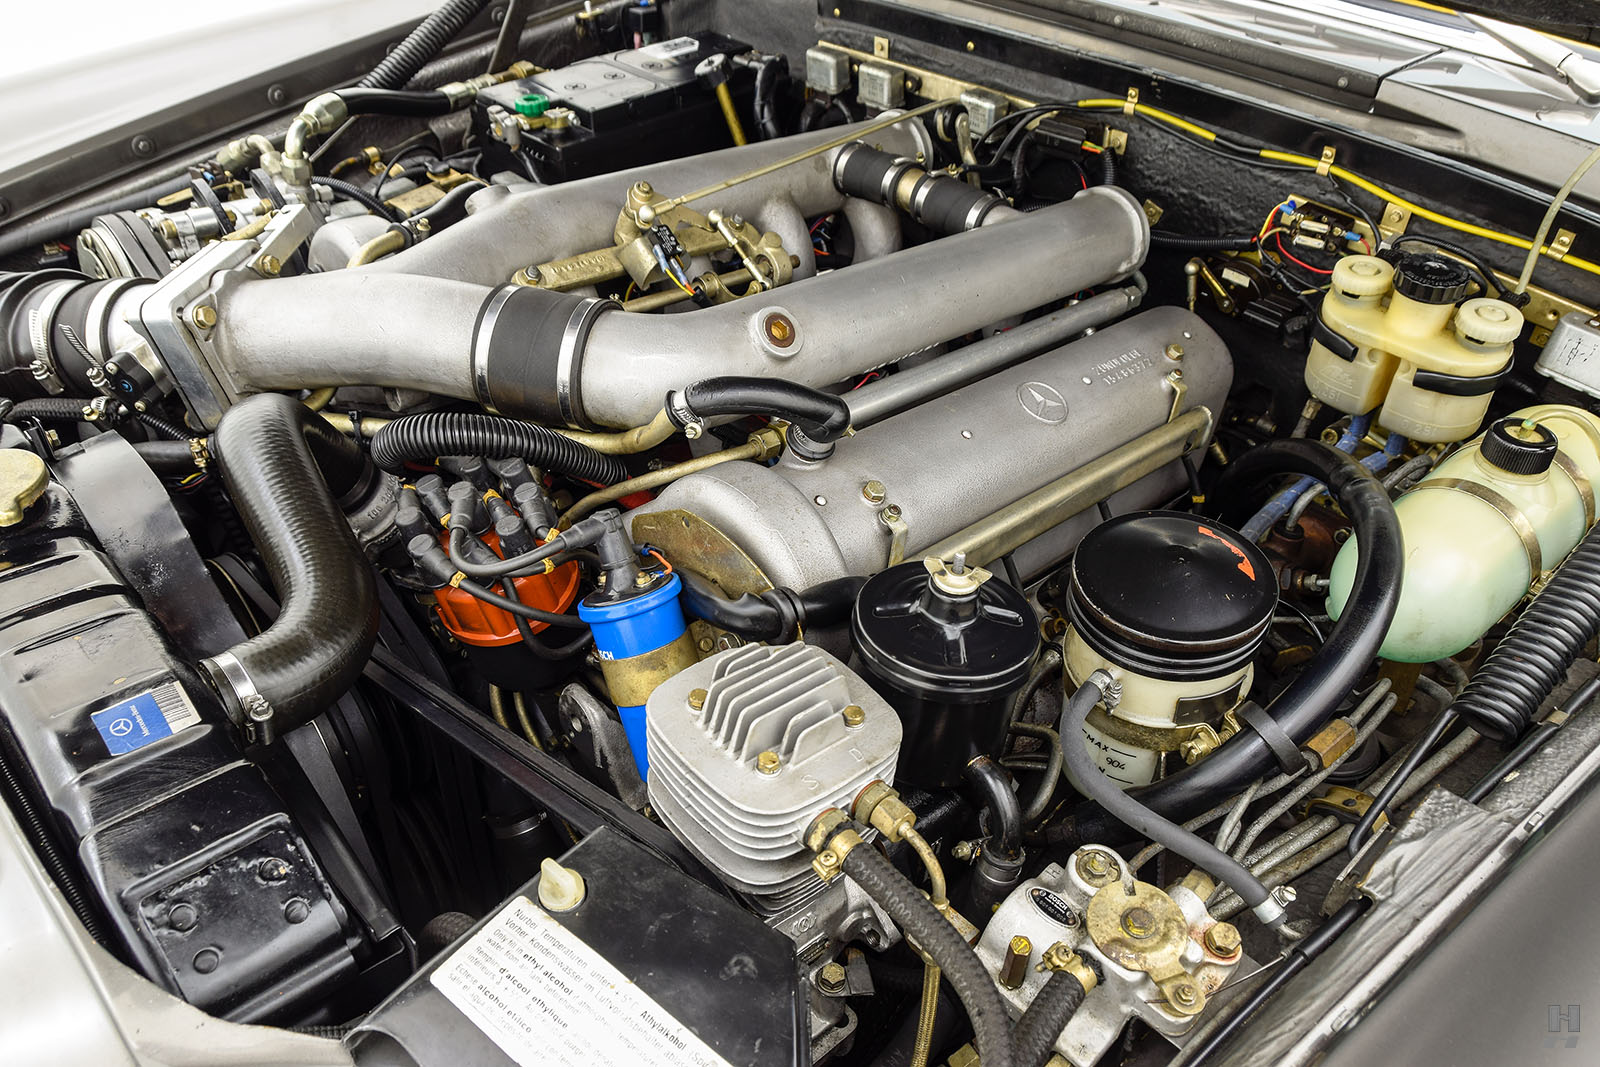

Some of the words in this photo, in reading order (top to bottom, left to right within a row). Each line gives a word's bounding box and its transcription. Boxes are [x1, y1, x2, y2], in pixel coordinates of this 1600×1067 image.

[1086, 734, 1109, 752] MAX
[848, 748, 864, 762] D
[801, 774, 820, 790] S
[1048, 894, 1068, 910] BOSCH
[486, 937, 503, 952] water
[505, 918, 528, 938] Vorher
[528, 937, 583, 983] Kondenswasser
[493, 929, 508, 942] Only
[515, 946, 523, 954] in
[522, 953, 544, 970] ethyl
[542, 970, 573, 995] alcohol
[540, 928, 587, 968] Temperaturen
[589, 969, 610, 986] unter
[498, 967, 531, 995] d'alcool
[476, 984, 507, 1010] alcohol
